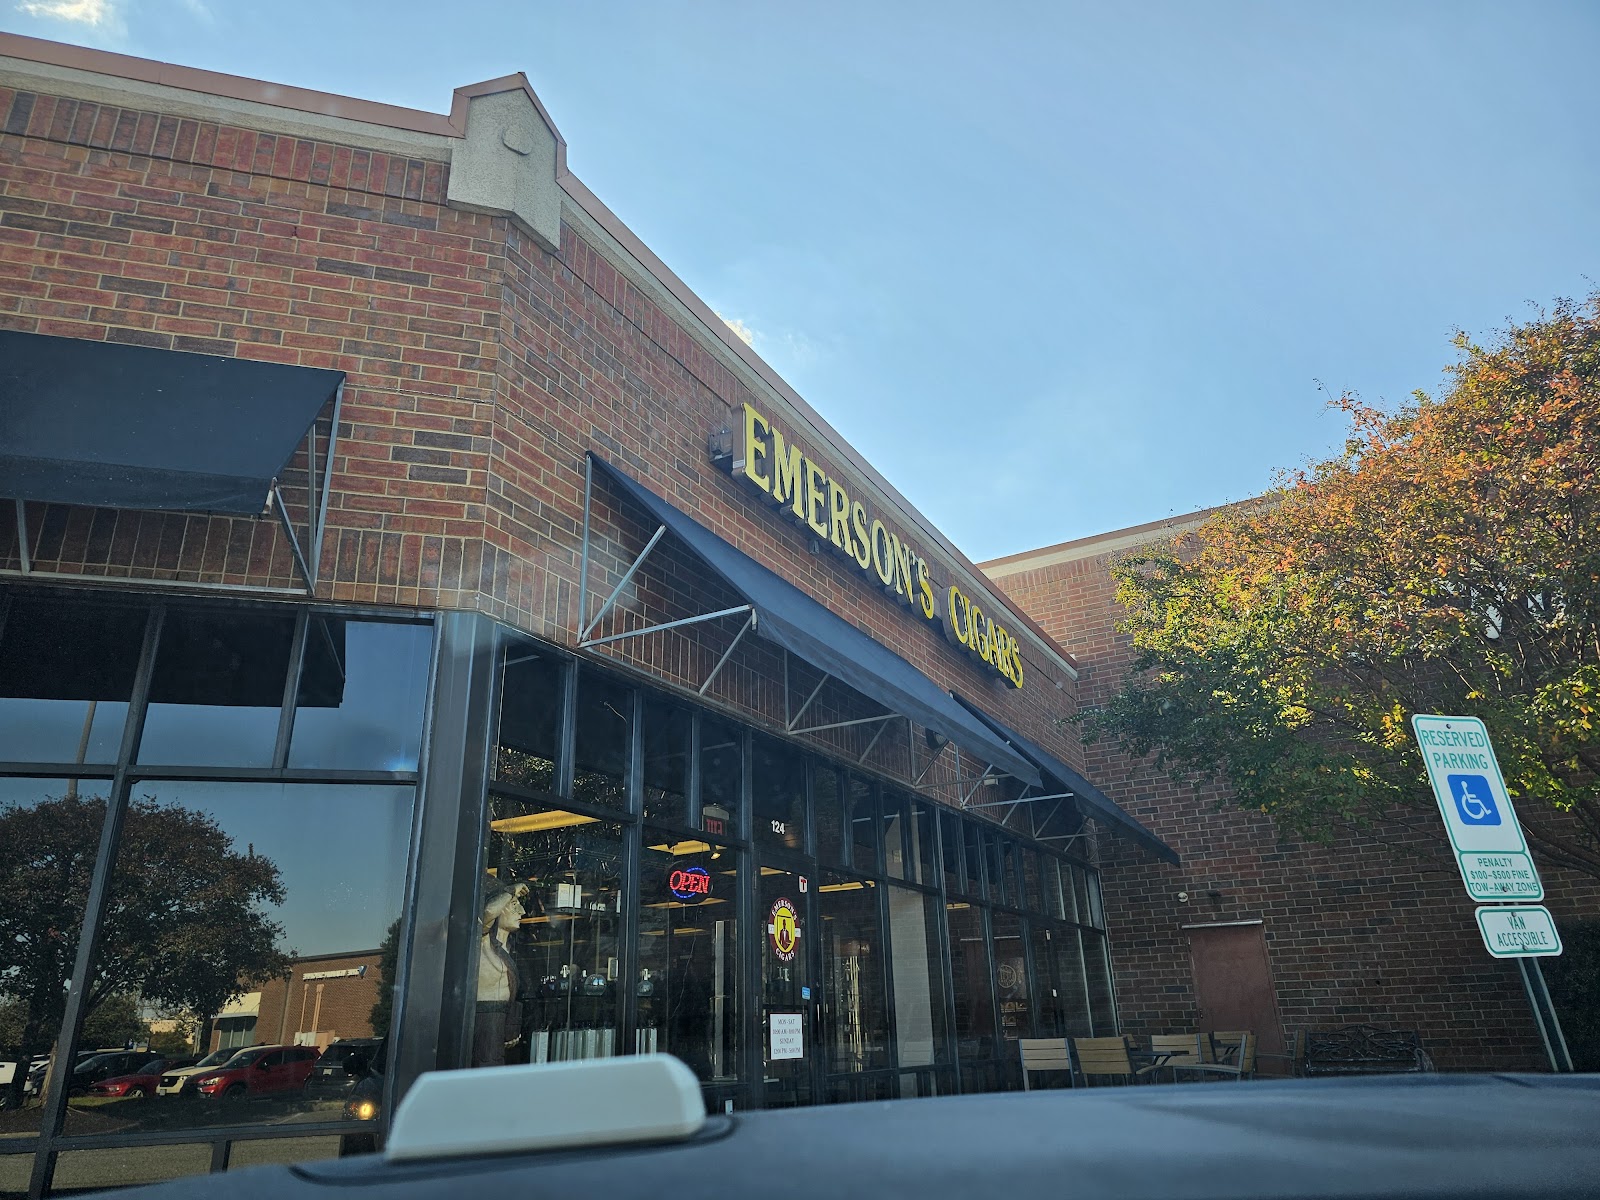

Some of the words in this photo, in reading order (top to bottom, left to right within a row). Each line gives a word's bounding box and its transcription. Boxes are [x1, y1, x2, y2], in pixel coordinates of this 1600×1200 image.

[742, 402, 935, 619] EMERSON'S
[947, 585, 1024, 689] CIGARS
[1420, 730, 1485, 747] RESERVED
[1432, 752, 1489, 770] PARKING
[771, 819, 786, 835] 124
[1477, 857, 1513, 868] PENALTY
[669, 870, 711, 894] OPEN
[1470, 870, 1511, 880] $100-$500
[1511, 870, 1530, 879] FINE
[1470, 882, 1515, 892] TOW-AWAY
[1516, 882, 1539, 892] ZONE
[771, 899, 798, 920] EMERSON'S
[1506, 916, 1527, 930] VAN
[1496, 931, 1549, 947] ACCESSIBLE
[775, 947, 795, 962] CIGARS
